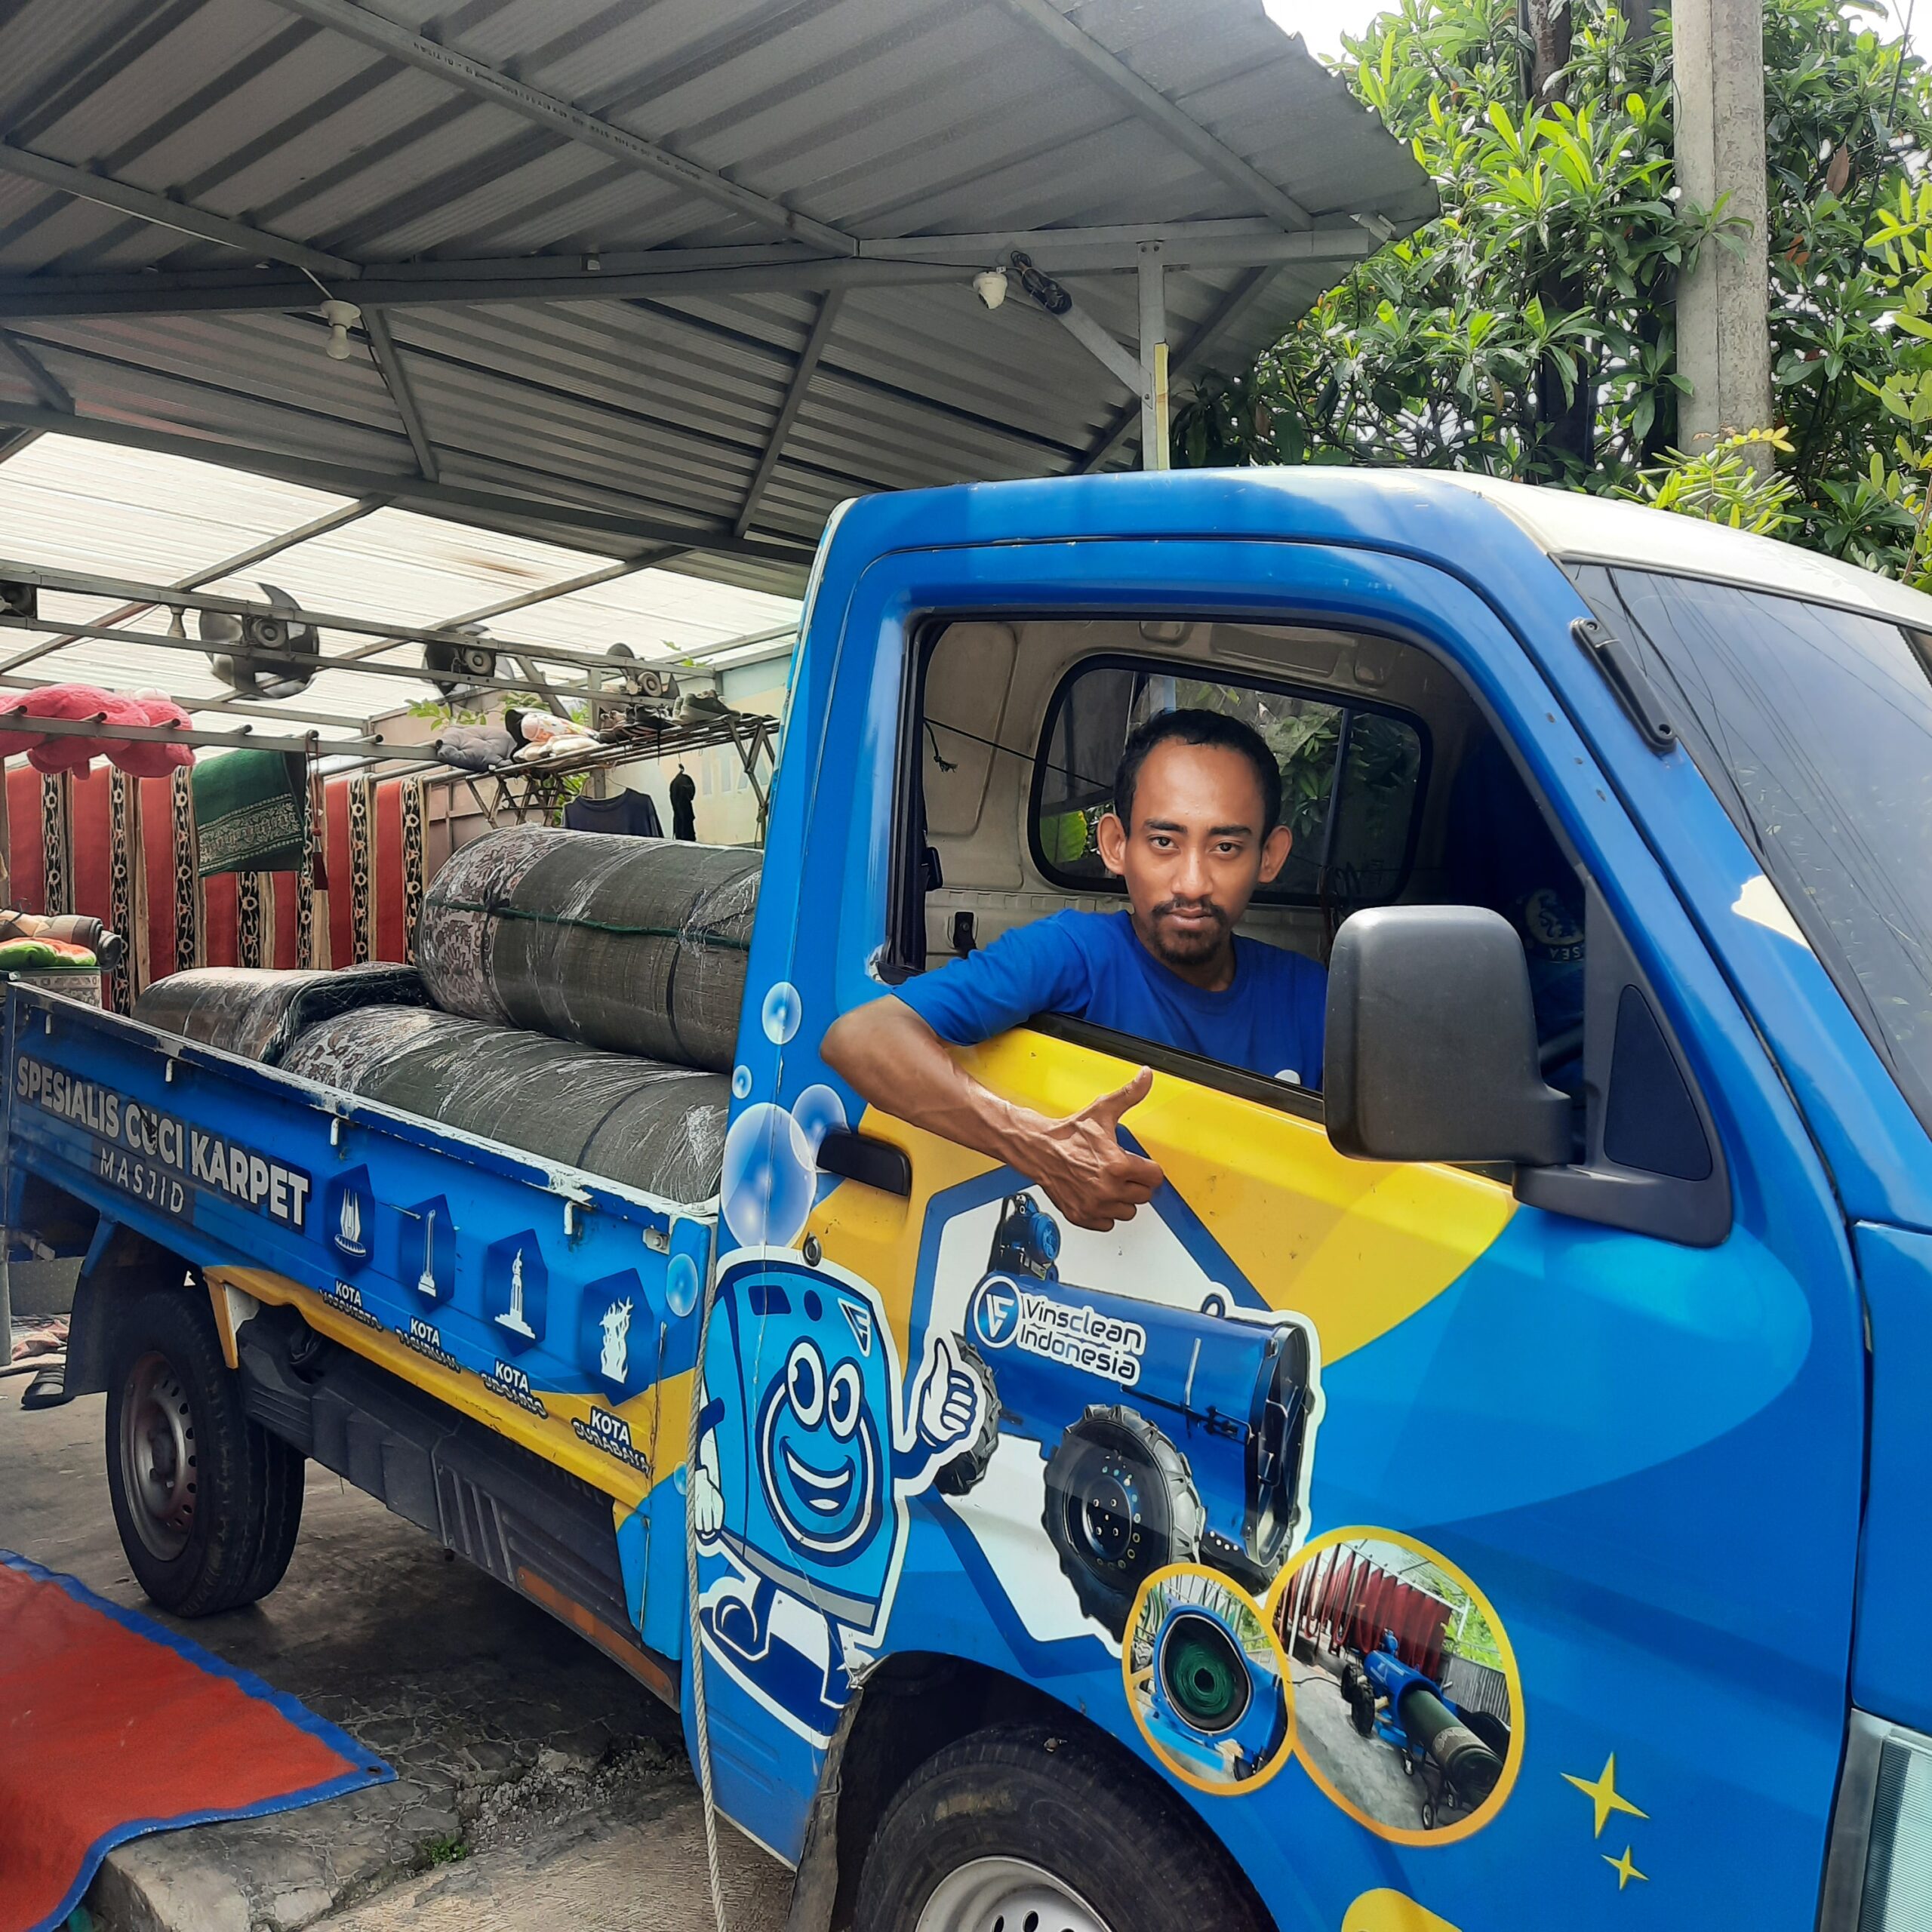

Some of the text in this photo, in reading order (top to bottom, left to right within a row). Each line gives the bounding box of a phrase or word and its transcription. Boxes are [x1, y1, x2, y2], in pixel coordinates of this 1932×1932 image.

[17, 1057, 309, 1226] SPESIALIS CUCI KARPET
[100, 1147, 184, 1214] MASJID
[335, 1280, 362, 1307] KOTA
[411, 1317, 441, 1347] KOTA
[1025, 1297, 1142, 1349] Vinsclean
[495, 1360, 529, 1392] KOTA
[1020, 1324, 1137, 1380] Indonesia
[572, 1421, 651, 1475] SURABAYA
[591, 1409, 630, 1445] KOTA
